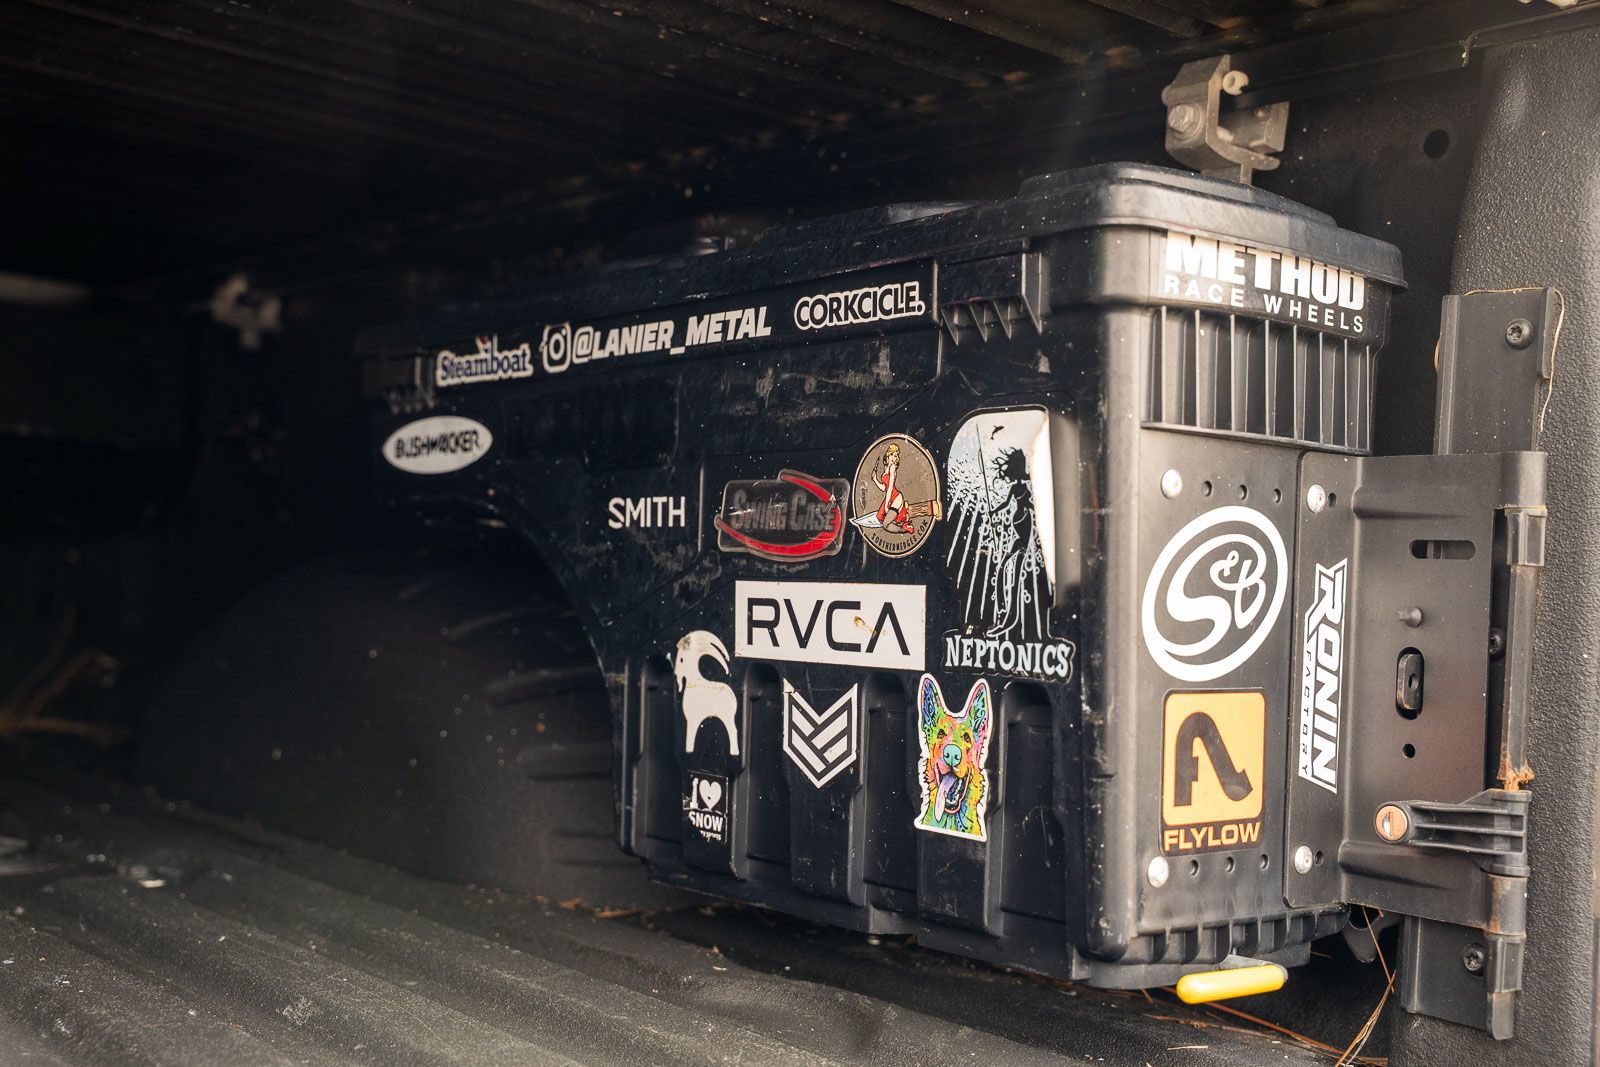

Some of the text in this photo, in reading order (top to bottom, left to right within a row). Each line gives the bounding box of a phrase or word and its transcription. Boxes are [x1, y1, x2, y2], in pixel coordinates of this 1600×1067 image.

[1165, 229, 1365, 310] METHOD
[796, 284, 924, 329] CORKCICLE.
[1163, 275, 1364, 333] RACE WHEELS
[572, 306, 772, 364] @LANIER_METAL
[440, 346, 529, 381] Steamboat
[394, 428, 480, 459] BUSHWACKER
[608, 496, 686, 529] SMITH
[944, 634, 1071, 678] NEPTONICS
[1307, 568, 1344, 787] RONIN
[1301, 649, 1312, 776] FACTORY
[688, 810, 724, 832] SNOW
[1163, 821, 1261, 851] FLYLOW
